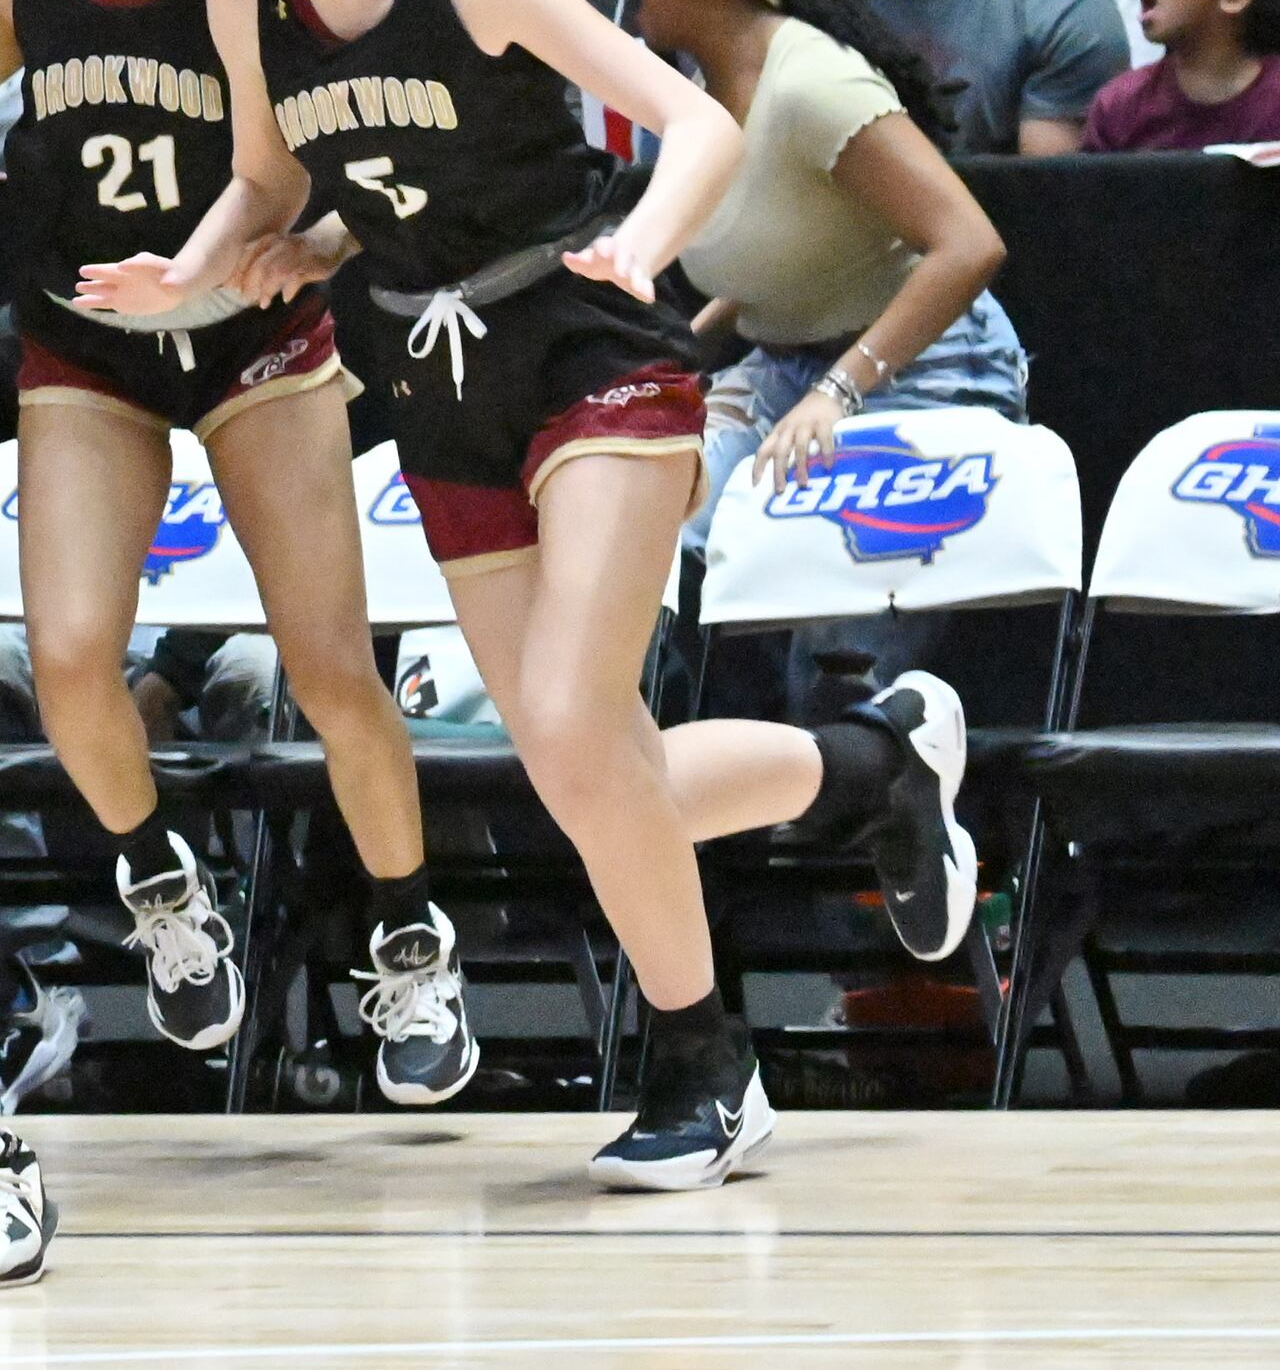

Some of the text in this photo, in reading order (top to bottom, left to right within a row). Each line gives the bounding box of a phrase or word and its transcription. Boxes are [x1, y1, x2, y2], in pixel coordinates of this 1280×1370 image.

[32, 55, 225, 122] BROOKWOOD
[81, 134, 181, 212] 21
[344, 156, 429, 220] 5
[768, 457, 989, 515] GHSA
